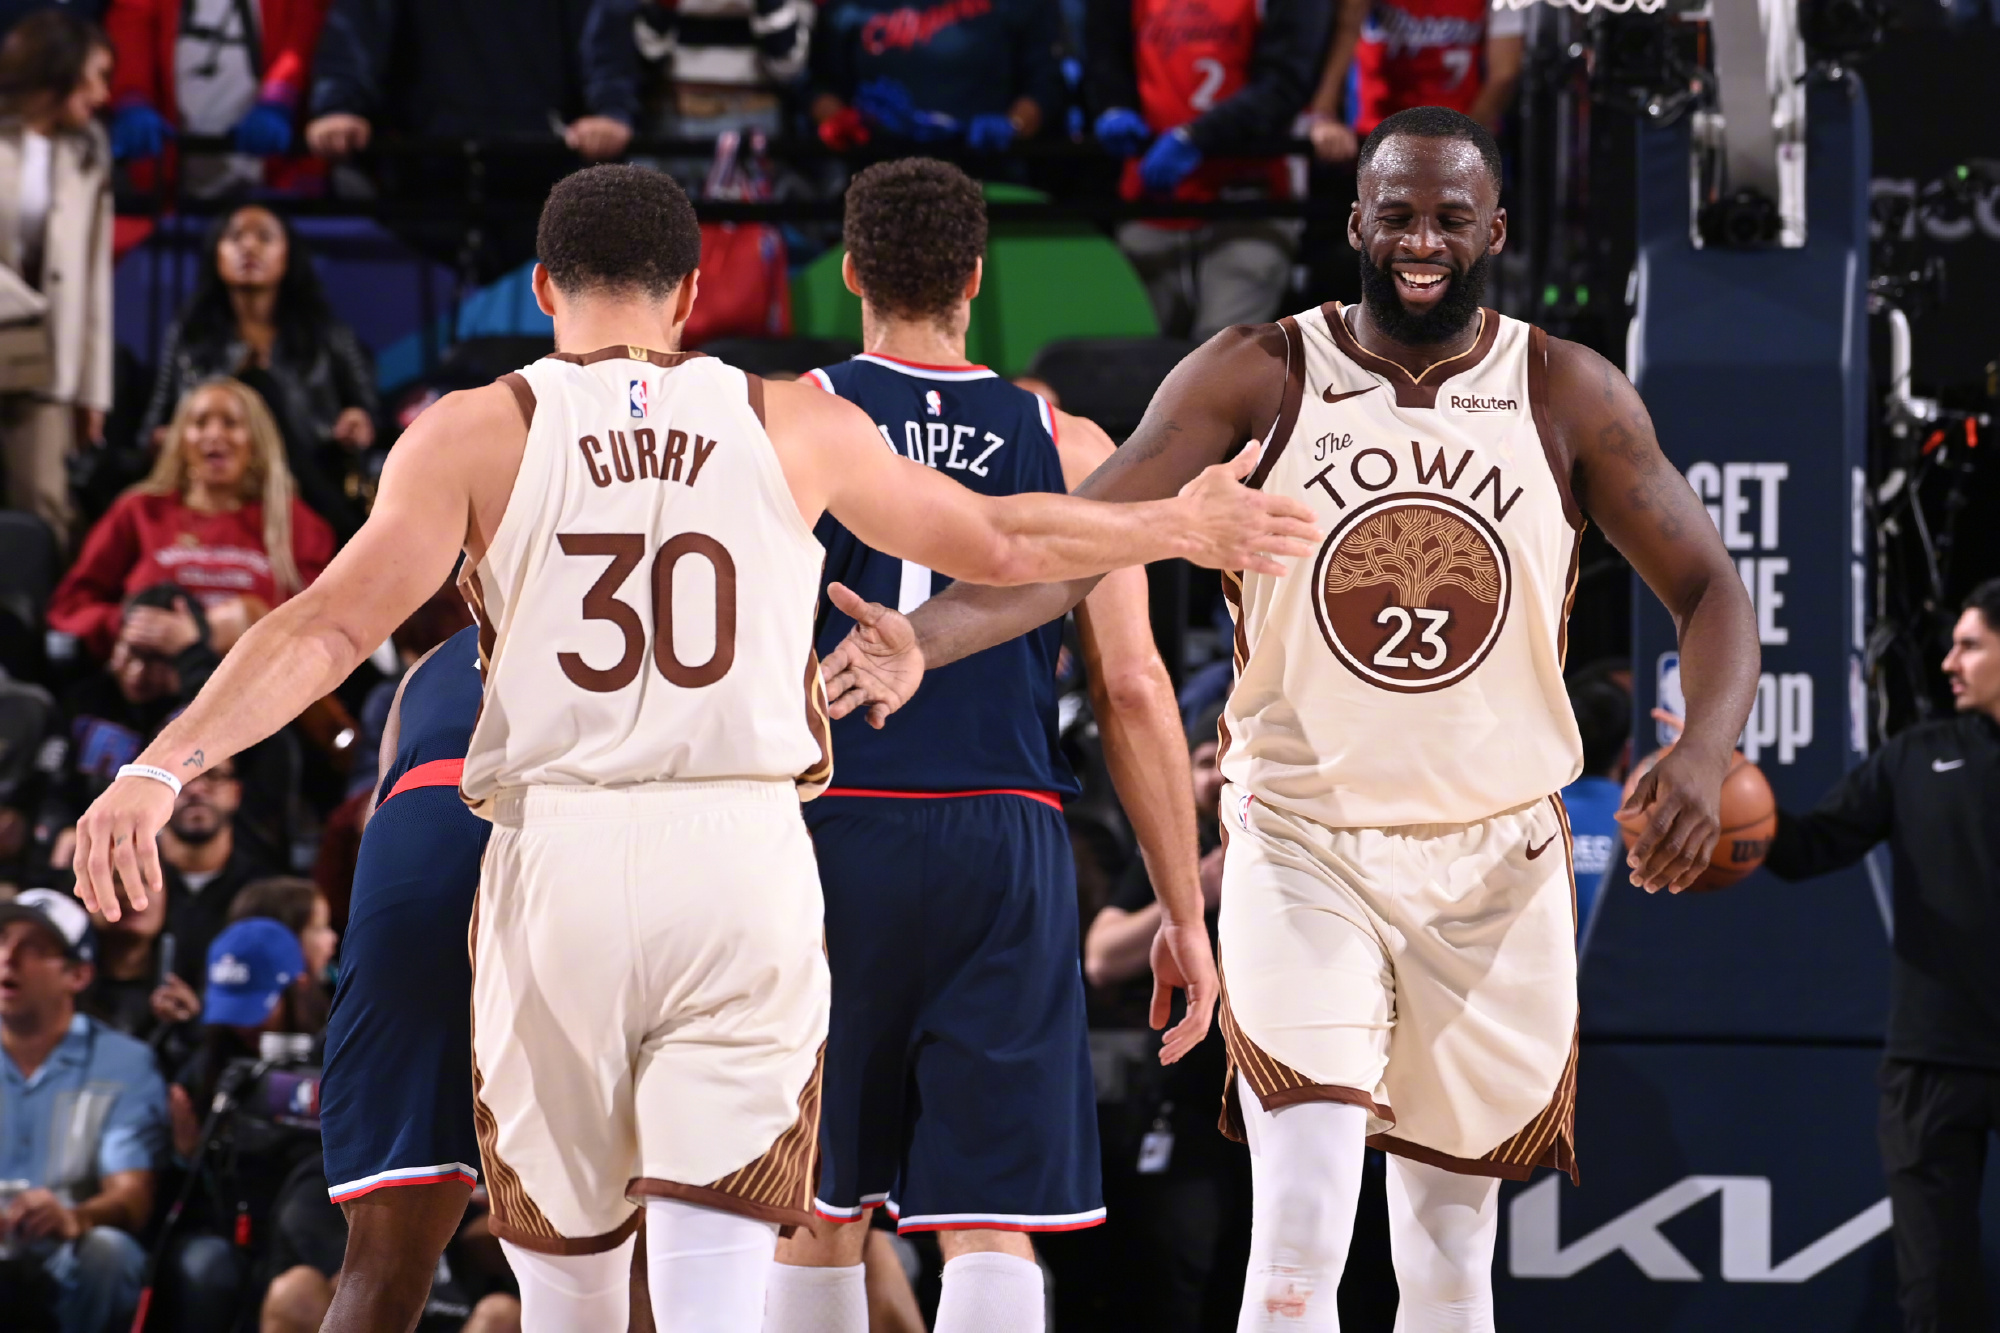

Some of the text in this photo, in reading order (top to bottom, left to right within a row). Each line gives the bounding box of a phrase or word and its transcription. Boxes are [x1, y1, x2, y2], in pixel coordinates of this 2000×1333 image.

[1189, 56, 1226, 111] 2
[1443, 48, 1472, 92] 7
[1451, 395, 1518, 411] Rakuten
[579, 427, 718, 488] CURRY
[1314, 433, 1354, 462] The
[1303, 440, 1524, 523] TOWN
[1686, 461, 1789, 550] GET
[556, 531, 737, 693] 30
[1373, 606, 1449, 670] 23
[1737, 672, 1814, 765] pp
